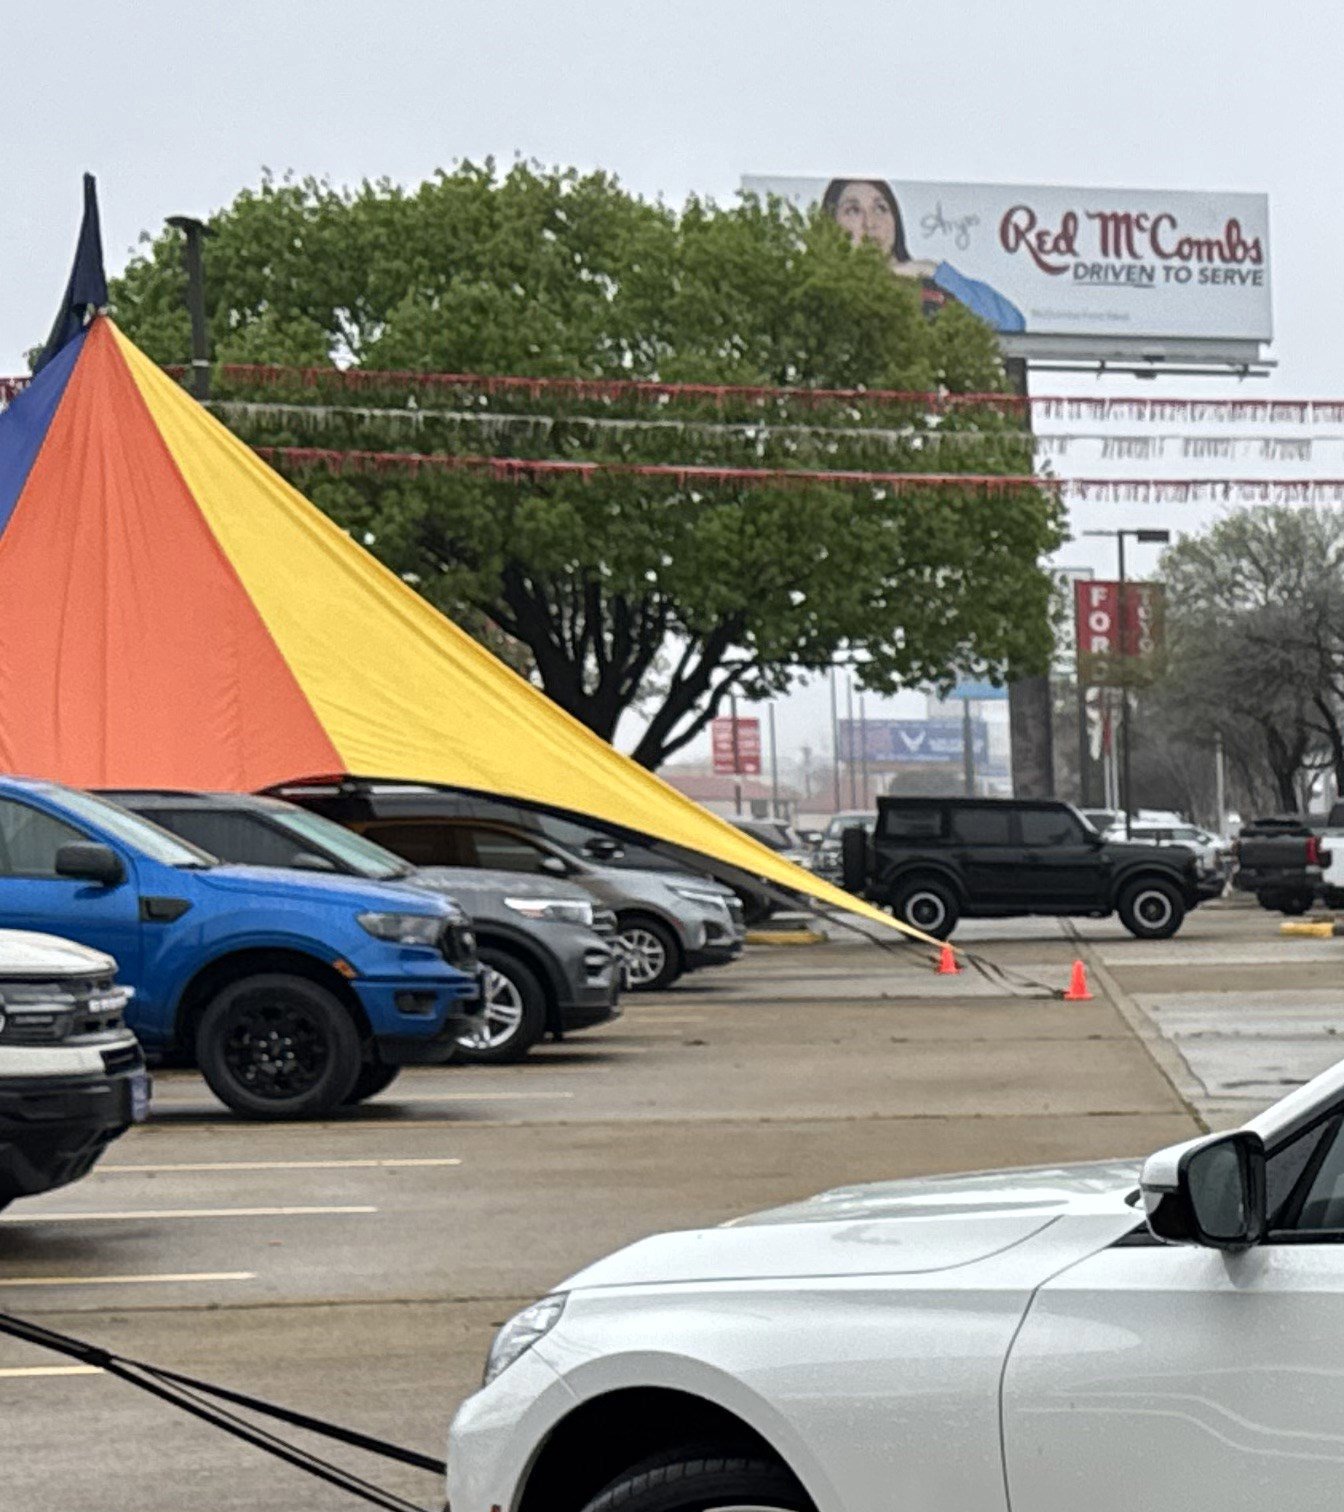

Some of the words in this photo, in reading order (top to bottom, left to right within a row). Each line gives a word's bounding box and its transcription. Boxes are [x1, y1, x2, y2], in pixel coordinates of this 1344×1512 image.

[1000, 205, 1080, 277] Red
[1086, 210, 1264, 266] McCombs
[1073, 261, 1155, 283] DRIVEN
[1164, 265, 1193, 284] TO
[1198, 268, 1264, 288] SERVE
